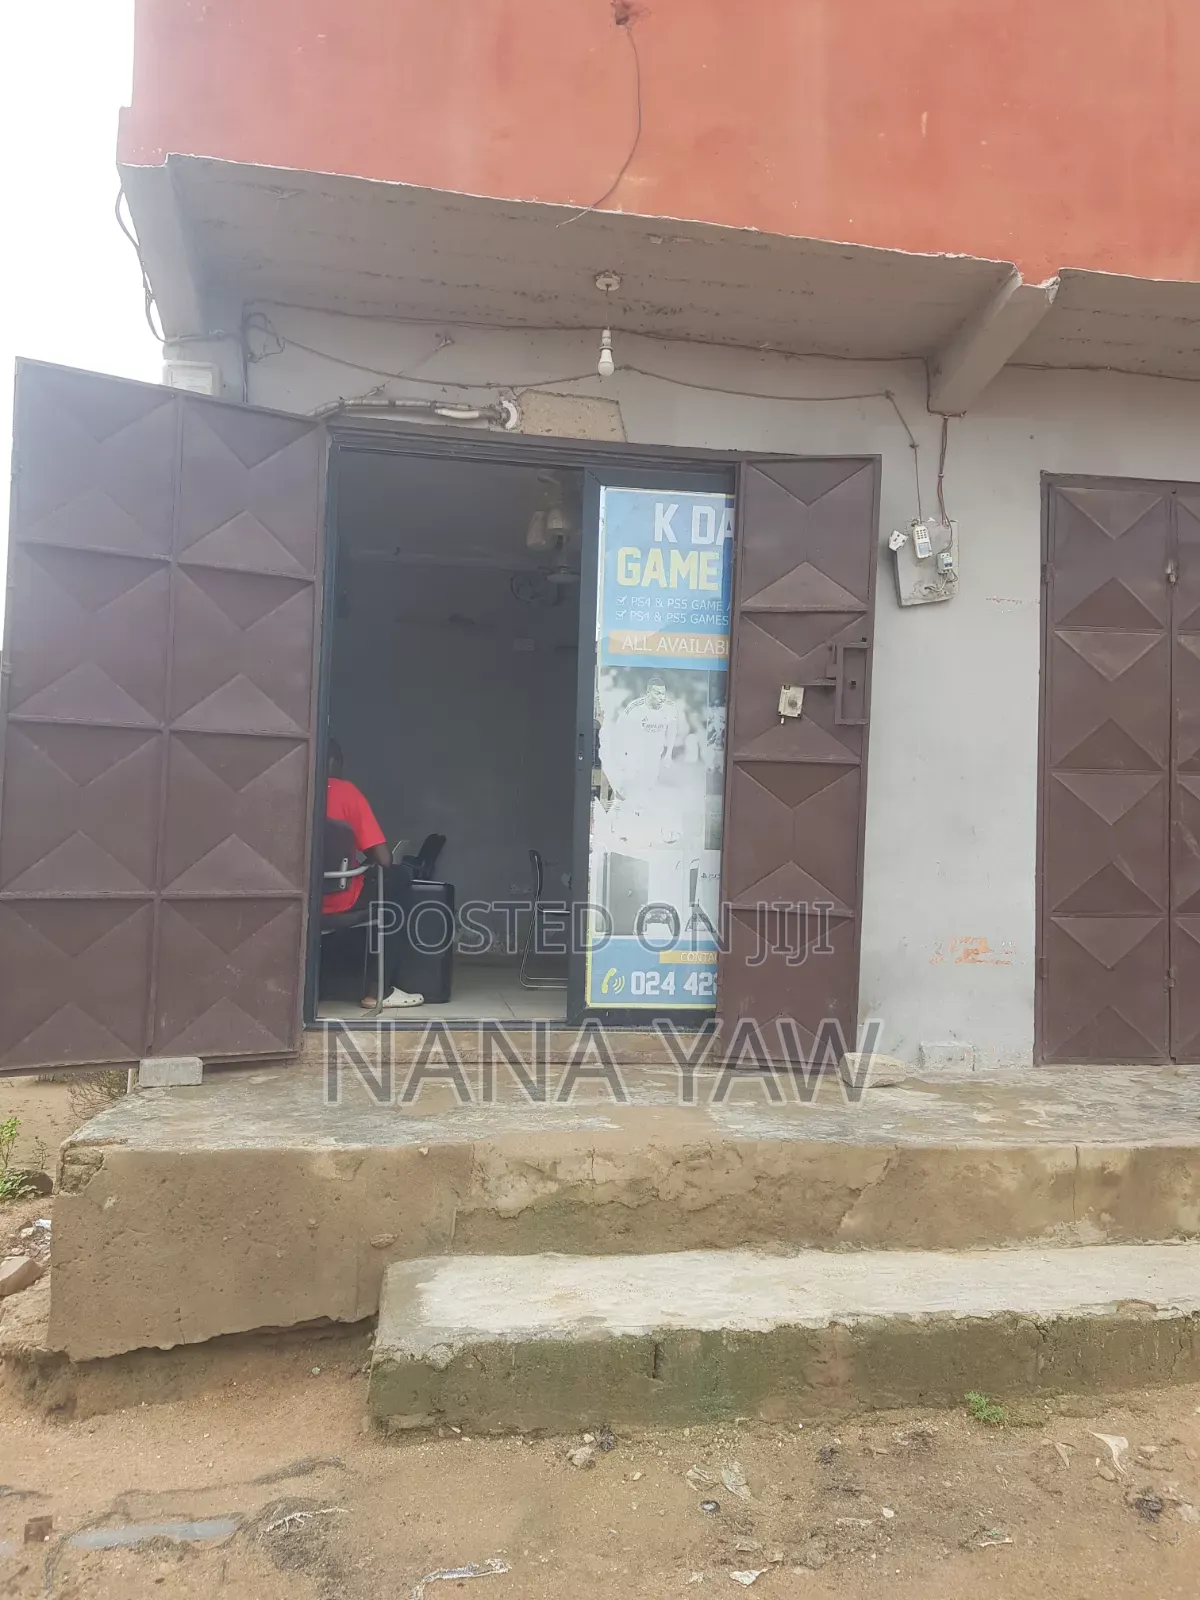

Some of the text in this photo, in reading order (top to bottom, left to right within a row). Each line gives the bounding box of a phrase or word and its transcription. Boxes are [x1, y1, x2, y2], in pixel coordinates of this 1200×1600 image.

[654, 502, 679, 543] K
[617, 546, 719, 591] GAME
[631, 596, 652, 607] PS4
[656, 598, 664, 608] &
[667, 598, 688, 609] PS5
[691, 599, 723, 611] GAME
[630, 610, 728, 626] PS4 & PS5 GAMES
[622, 635, 652, 651] ALL
[681, 952, 717, 962] CONTA
[630, 971, 675, 996] 024
